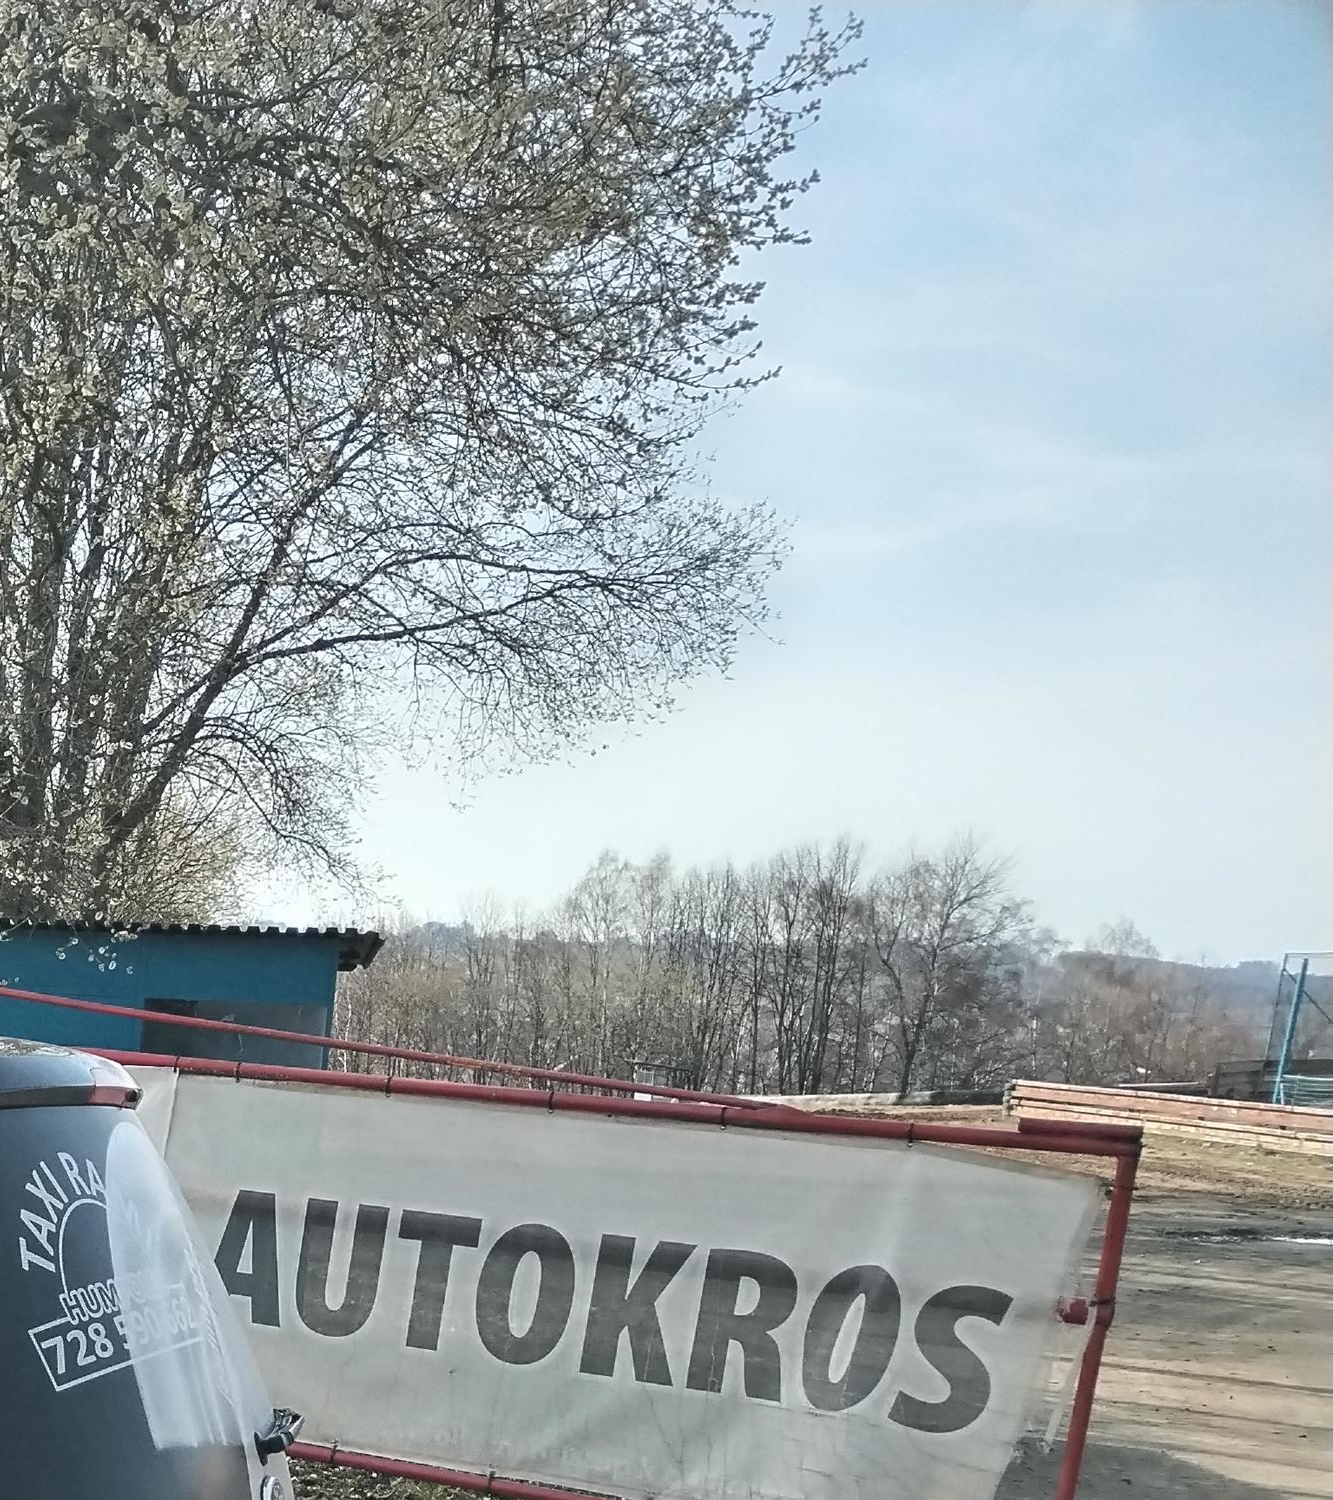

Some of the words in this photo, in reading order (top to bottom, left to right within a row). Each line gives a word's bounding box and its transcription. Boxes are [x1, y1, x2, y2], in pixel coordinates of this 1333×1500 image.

[19, 1161, 69, 1273] TAXI
[41, 1322, 114, 1375] 728
[214, 1189, 1014, 1433] AUTOKROS
